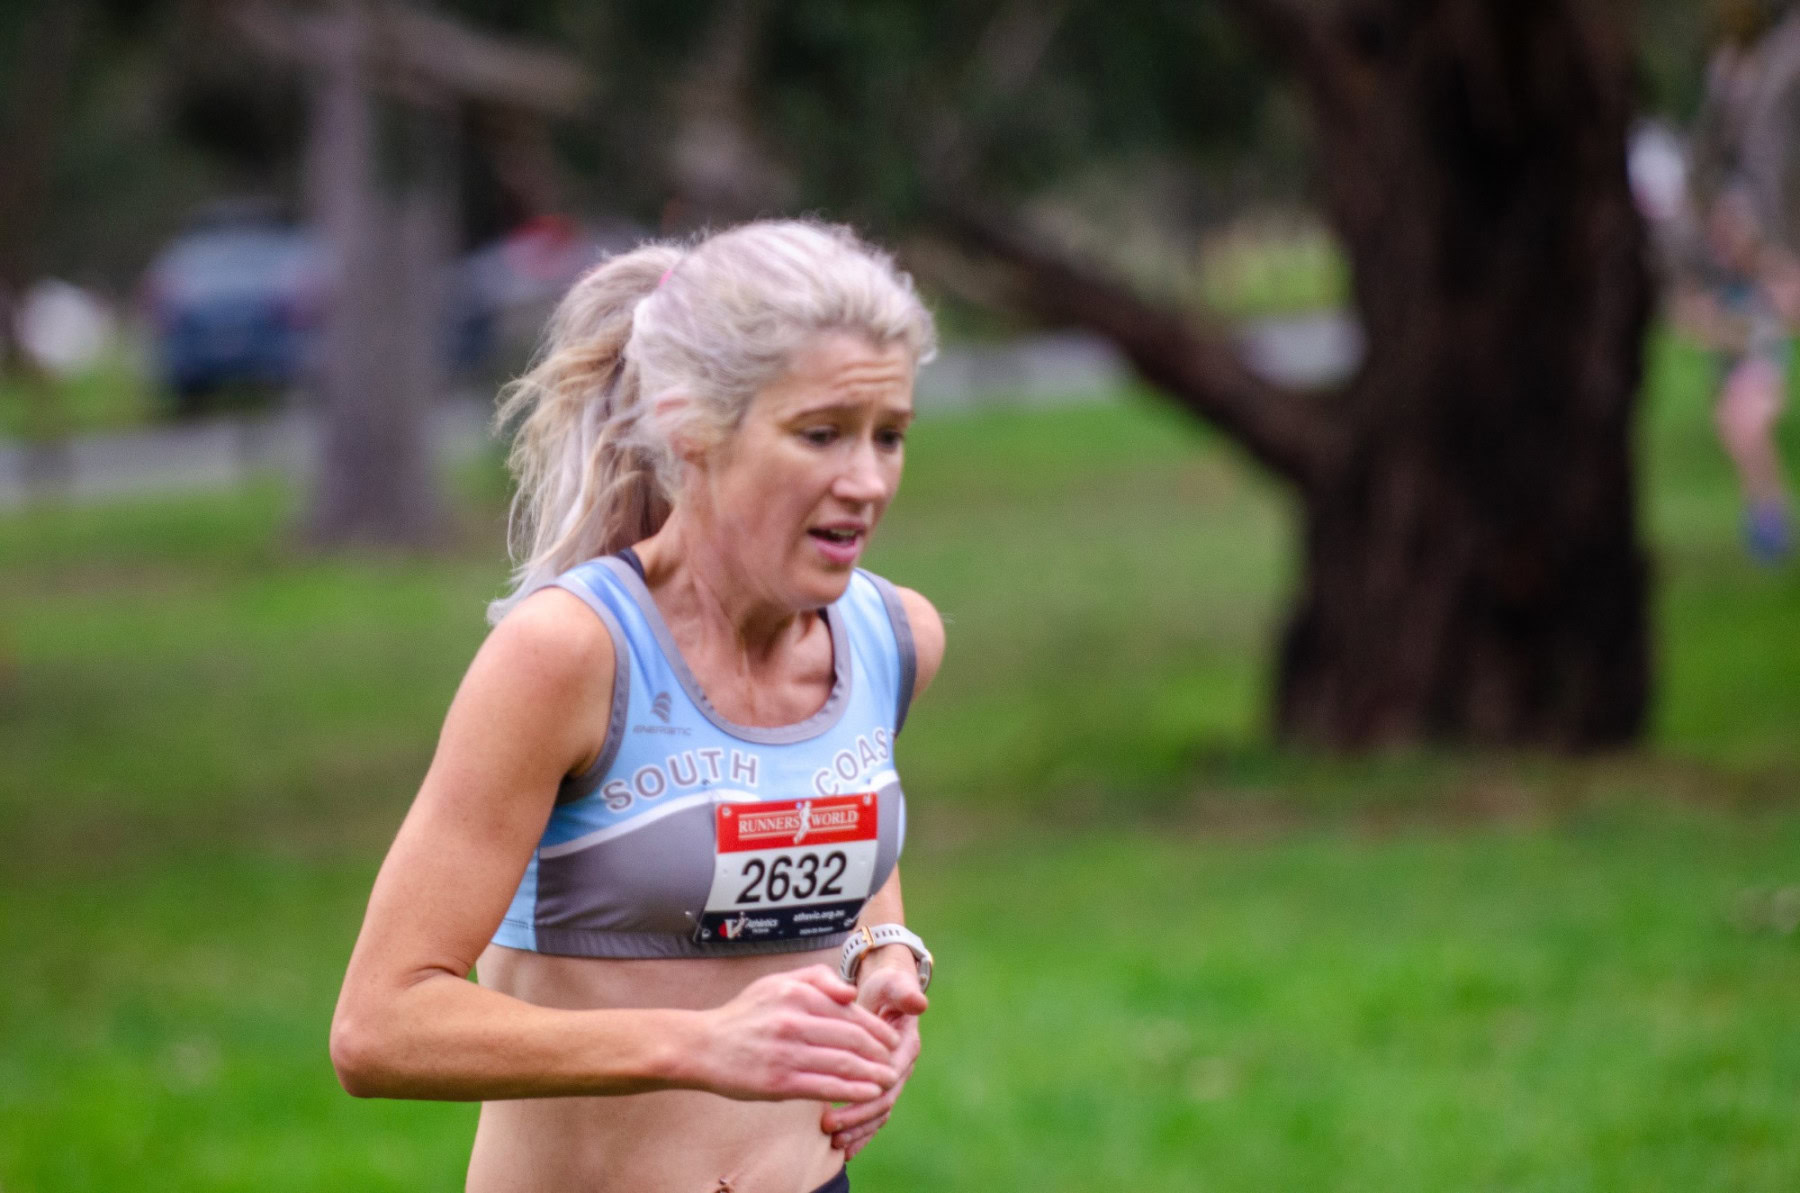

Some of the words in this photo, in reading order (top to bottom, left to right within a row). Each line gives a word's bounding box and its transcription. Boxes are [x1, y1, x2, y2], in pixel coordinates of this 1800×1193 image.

[602, 748, 760, 811] SOUTH
[813, 727, 894, 796] COAS
[738, 816, 800, 834] RUNNERS
[810, 809, 859, 827] WORLD
[736, 851, 847, 904] 2632
